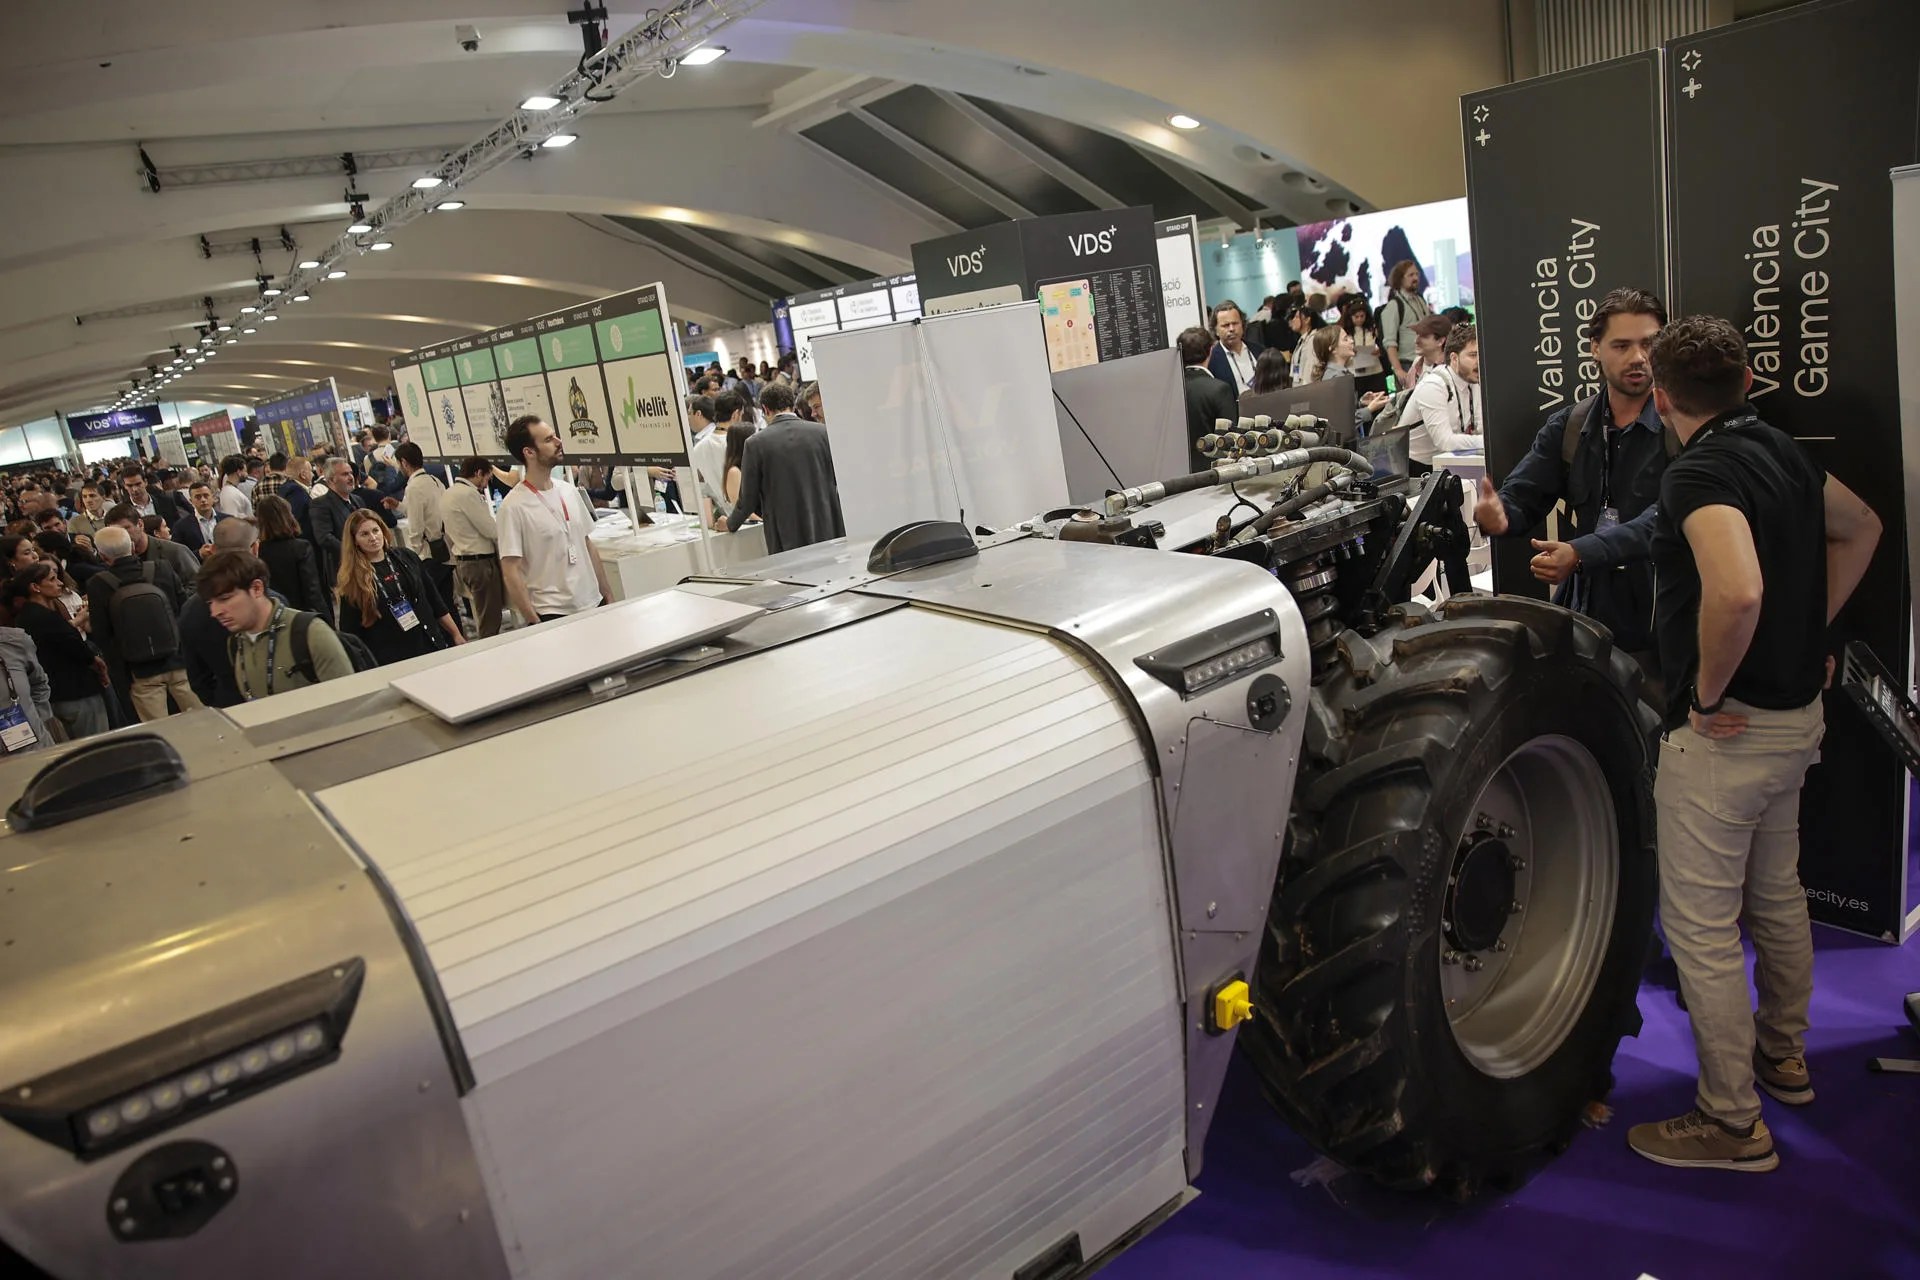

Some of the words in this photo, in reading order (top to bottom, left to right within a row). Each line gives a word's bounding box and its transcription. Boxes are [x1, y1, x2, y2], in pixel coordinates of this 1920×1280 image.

[1566, 218, 1601, 289] City
[1792, 178, 1839, 259] City
[1530, 257, 1564, 411] València
[1574, 298, 1600, 403] Game
[1745, 224, 1780, 400] València
[1793, 271, 1830, 397] Game
[636, 396, 669, 418] Wellit
[1806, 888, 1869, 912] ecity.es
